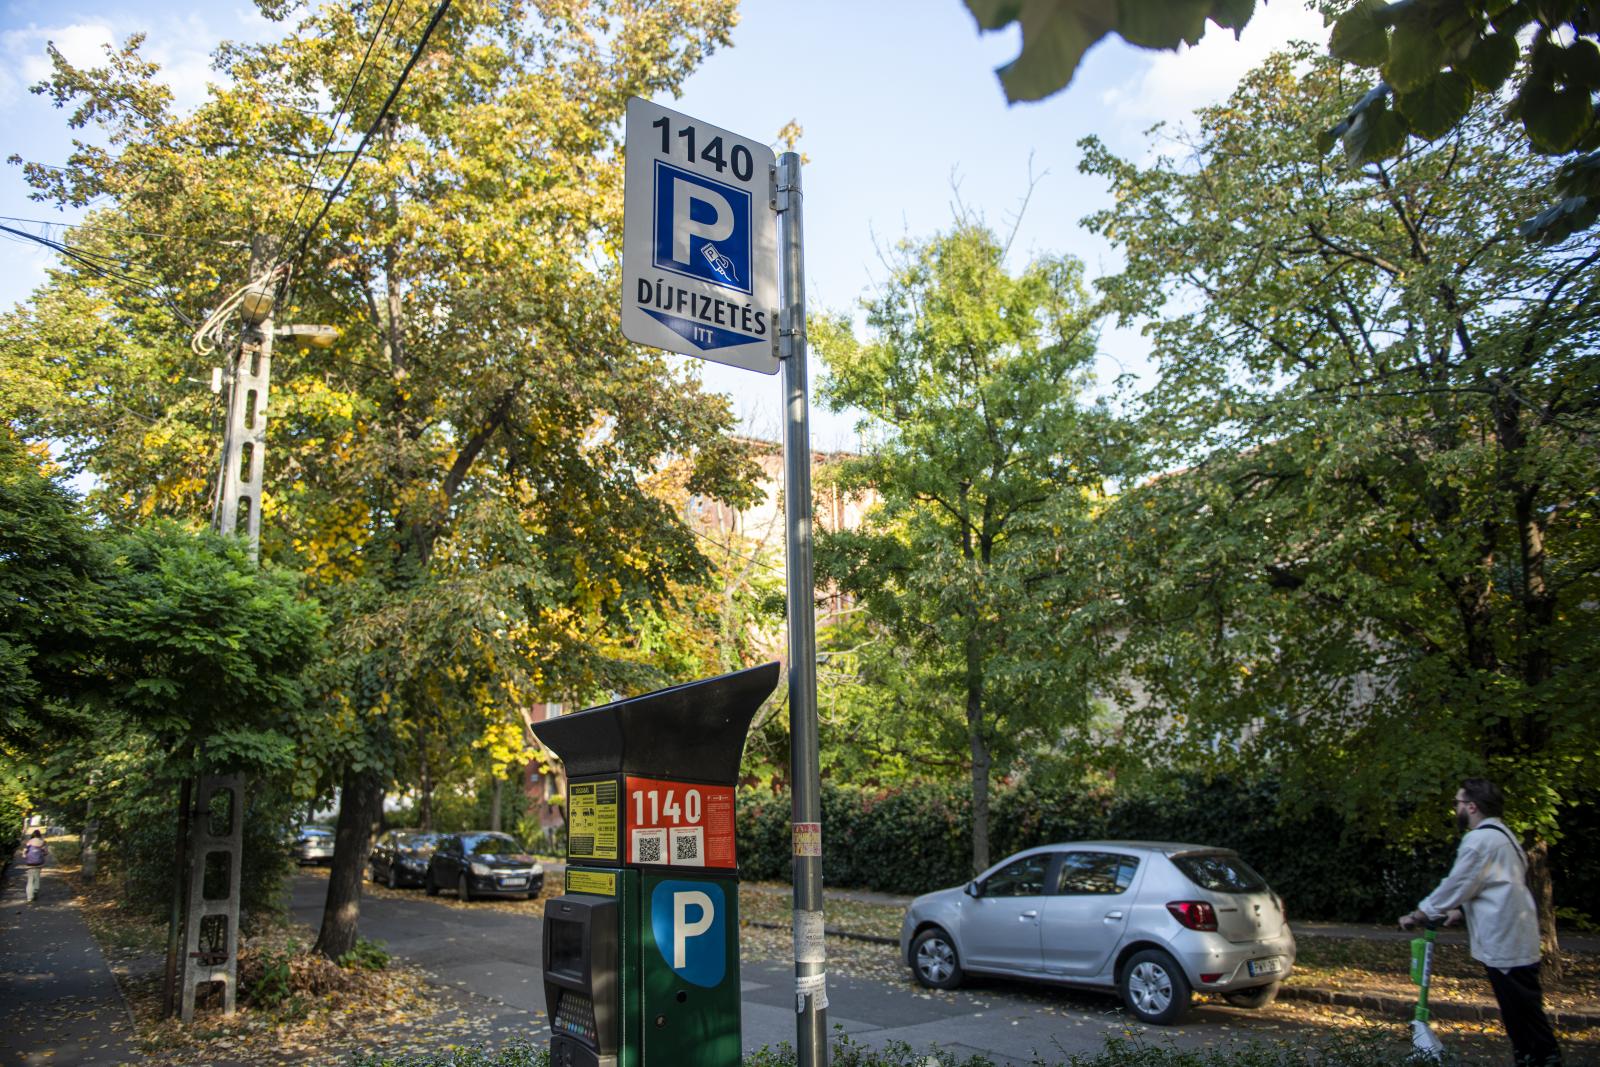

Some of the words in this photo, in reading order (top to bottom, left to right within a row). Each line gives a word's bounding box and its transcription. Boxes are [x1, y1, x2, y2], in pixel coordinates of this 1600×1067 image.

[653, 116, 753, 182] 1140
[672, 177, 734, 265] P
[637, 277, 766, 335] DÍJFIZETÉS
[694, 326, 713, 344] ITT
[633, 789, 701, 825] 1140
[673, 890, 715, 969] P
